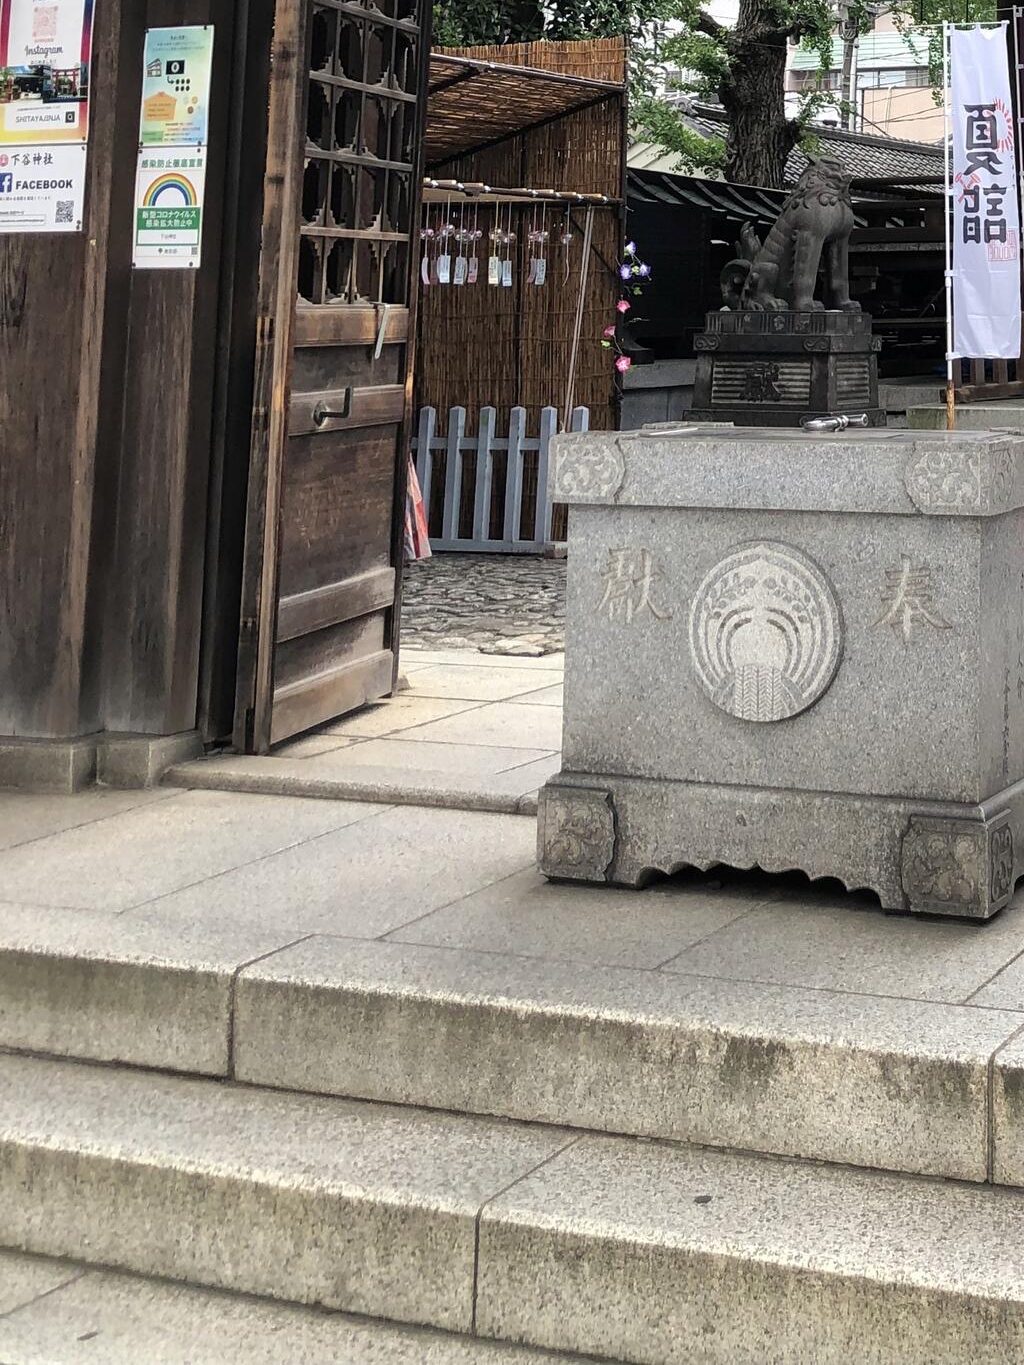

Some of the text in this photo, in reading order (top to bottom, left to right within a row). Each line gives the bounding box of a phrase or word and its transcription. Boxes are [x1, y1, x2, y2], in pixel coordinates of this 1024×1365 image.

[24, 44, 64, 59] Instagram
[15, 113, 61, 124] SHITAYAJINJA
[10, 152, 54, 167] 下谷神社
[963, 103, 1007, 245] 夏詣
[16, 179, 73, 191] FACEBOOK
[142, 210, 197, 219] 新型コロナウイルス
[872, 553, 954, 644] 奉
